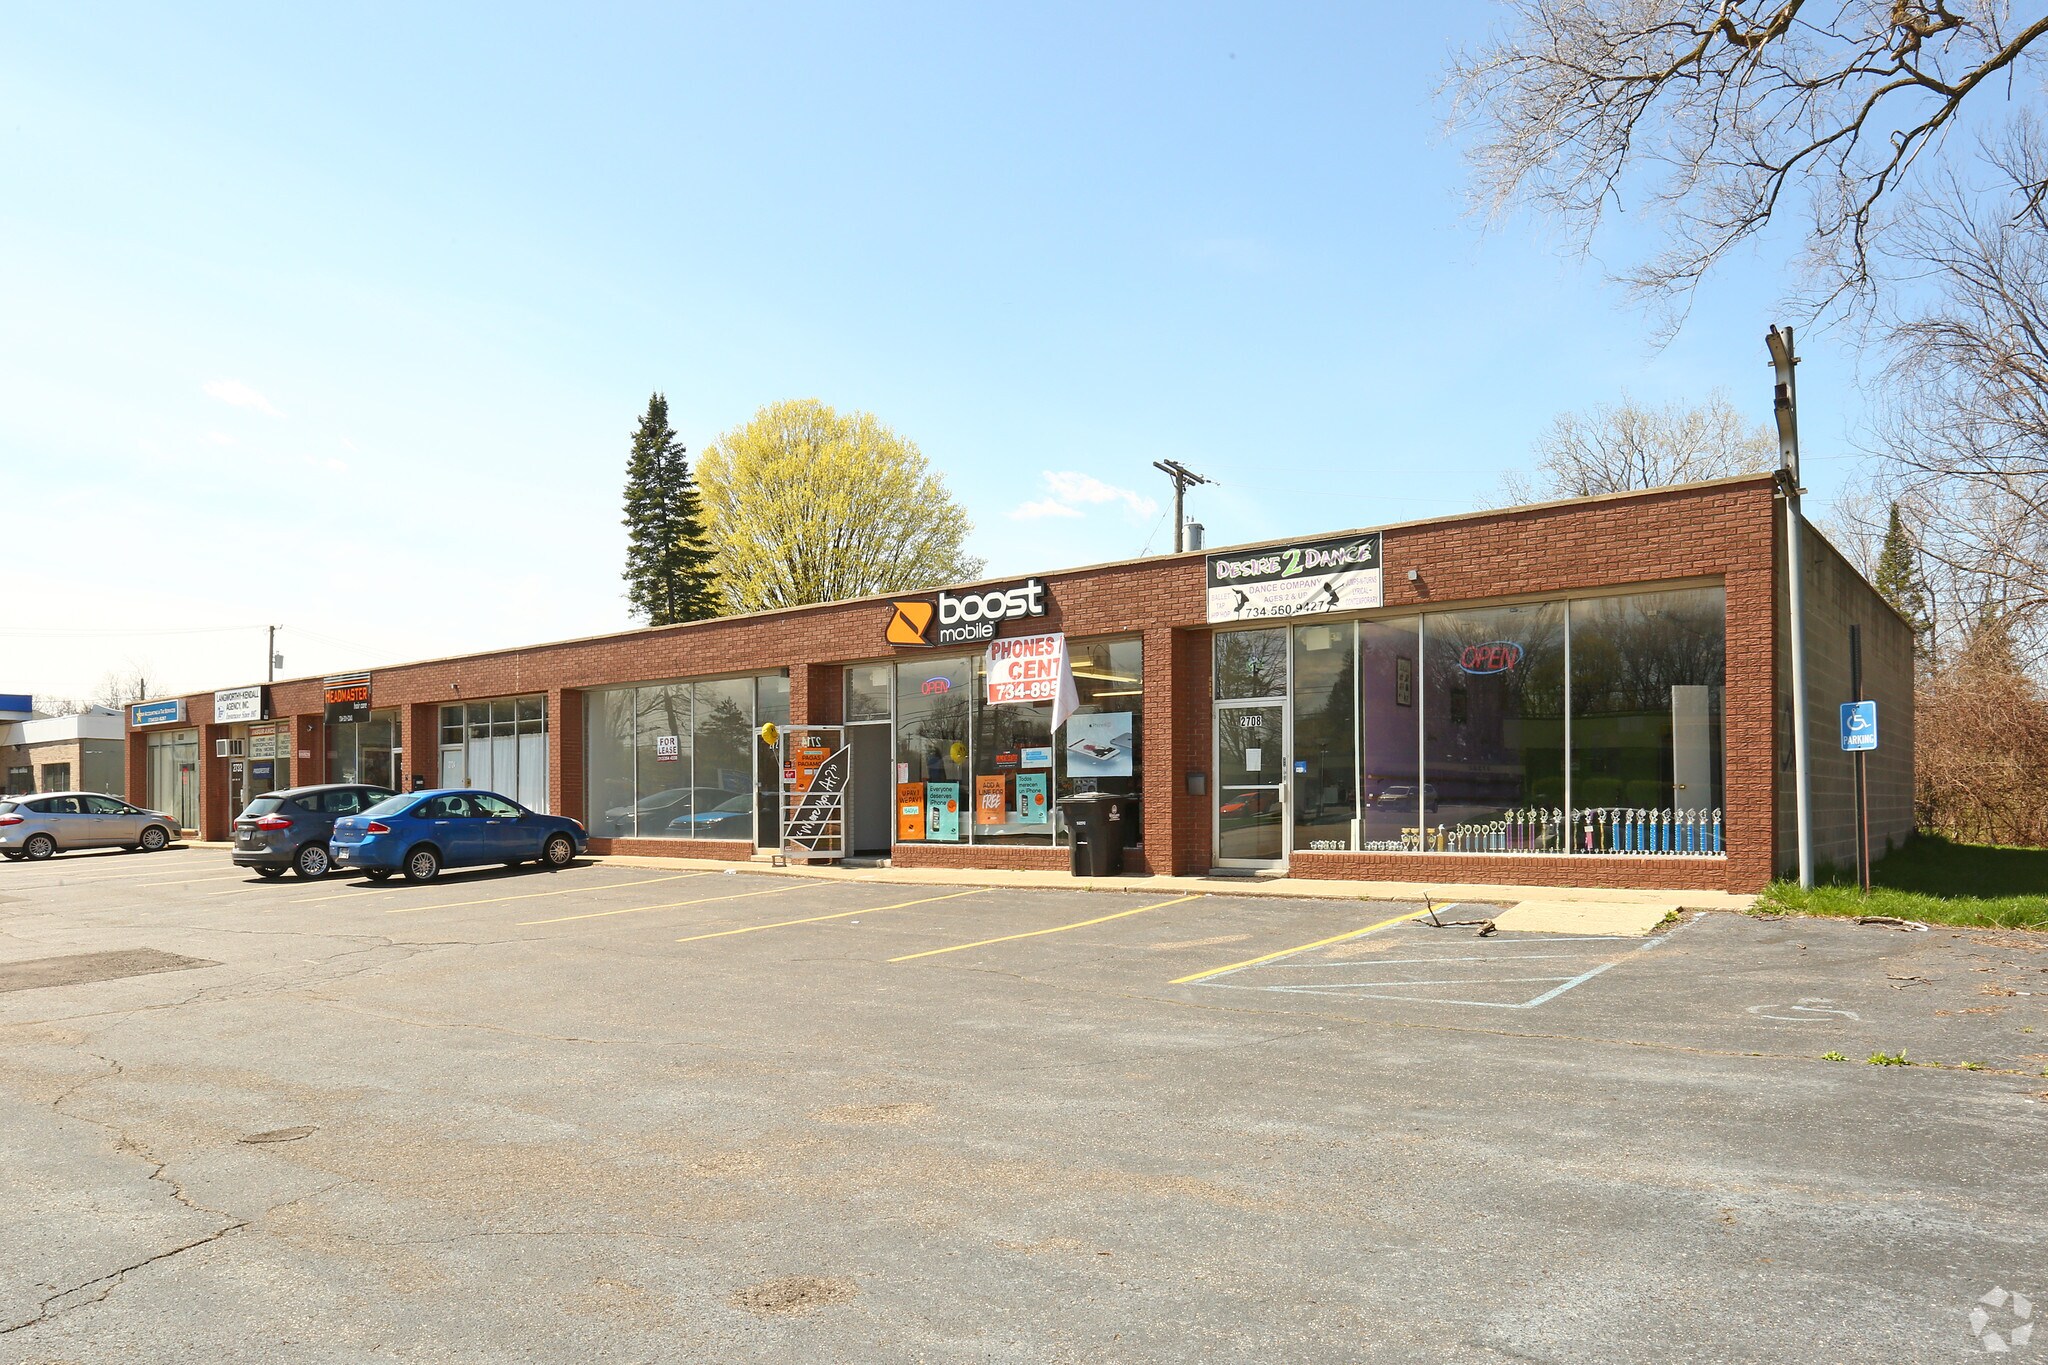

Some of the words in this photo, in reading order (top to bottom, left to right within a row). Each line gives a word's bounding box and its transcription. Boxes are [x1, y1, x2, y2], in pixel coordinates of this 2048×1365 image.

[1216, 555, 1281, 580] DESIRE
[1281, 547, 1304, 578] 2
[1305, 543, 1371, 567] DANCE
[1249, 583, 1278, 595] DANCE
[1280, 578, 1323, 592] COMPANY
[938, 579, 1043, 625] boost
[1264, 594, 1284, 603] AGES
[1285, 593, 1290, 601] 2
[1291, 592, 1297, 600] &
[1298, 591, 1308, 599] UP
[991, 636, 1055, 661] PHONES
[1461, 645, 1519, 670] OPEN
[325, 686, 368, 704] HEADMASTER
[922, 680, 949, 695] OPEN
[1240, 716, 1262, 727] 2708
[659, 737, 675, 746] FOR
[1843, 733, 1874, 746] PARKING
[658, 746, 677, 755] LEASE
[981, 793, 1001, 810] FREE
